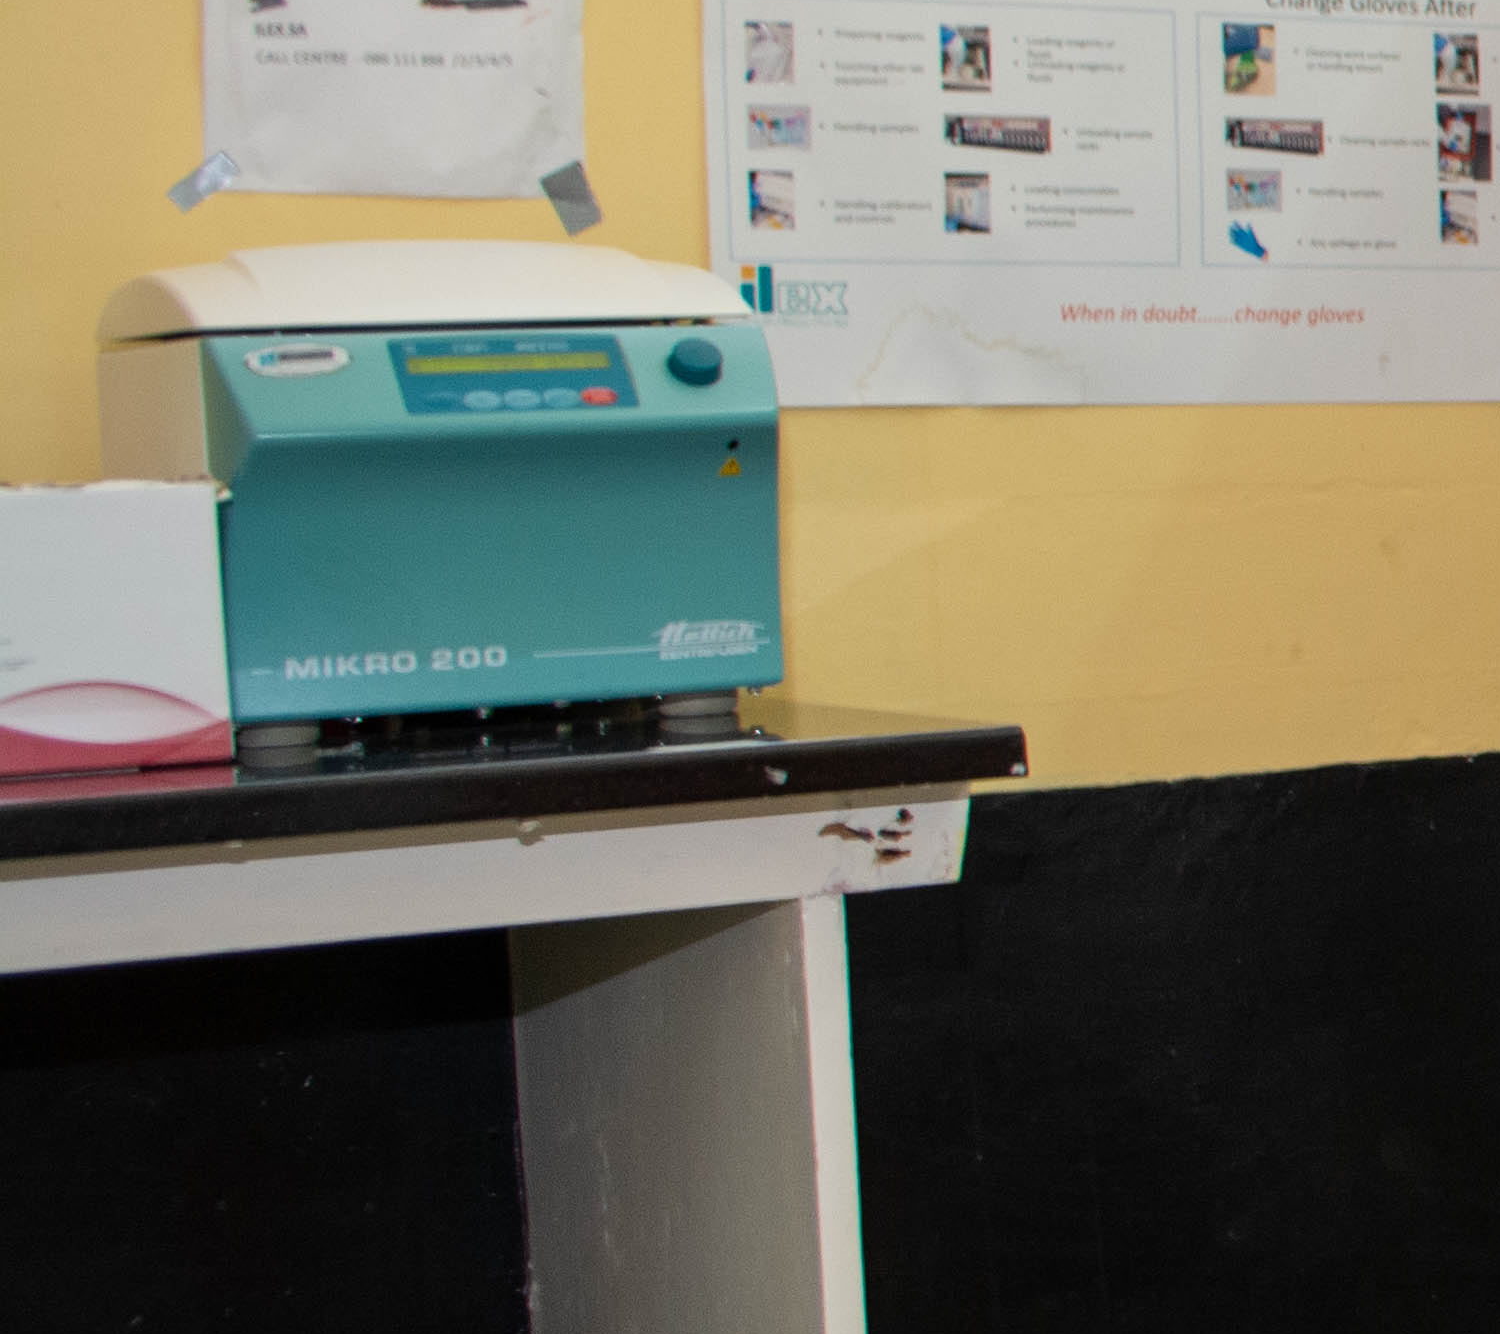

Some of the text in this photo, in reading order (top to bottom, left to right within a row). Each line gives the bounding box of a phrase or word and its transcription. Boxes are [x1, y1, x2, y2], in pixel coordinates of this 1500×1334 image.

[1060, 303, 1115, 323] When
[1121, 304, 1137, 323] in
[1308, 304, 1366, 328] gloves
[284, 644, 508, 681] MIKRO 200
